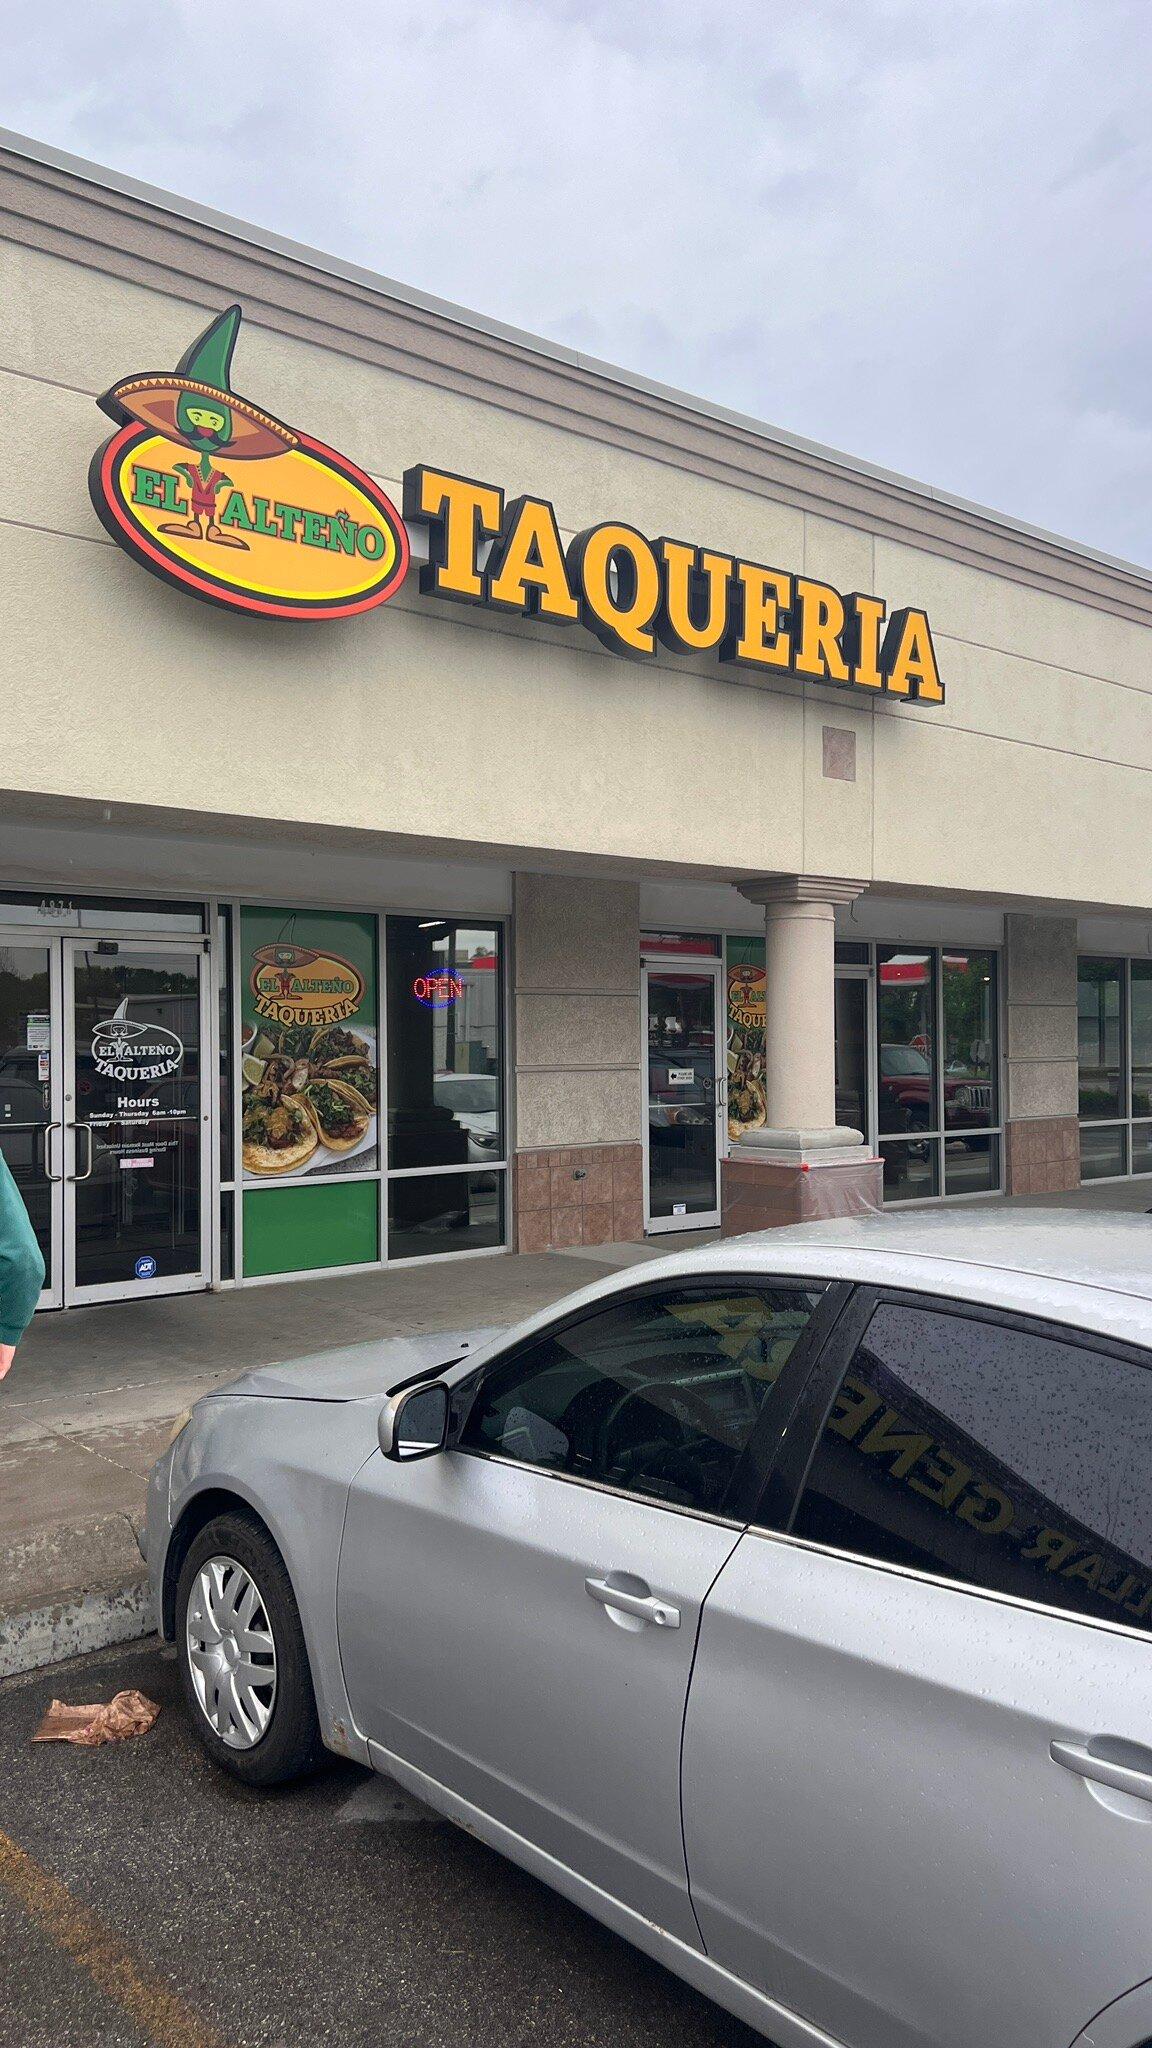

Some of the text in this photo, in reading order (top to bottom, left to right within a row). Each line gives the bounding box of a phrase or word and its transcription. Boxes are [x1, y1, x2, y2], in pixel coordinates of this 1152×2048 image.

[131, 466, 386, 562] EL ALTEÑO
[410, 464, 945, 705] TAQUERIA
[260, 977, 354, 993] EL ALTEÑO
[413, 977, 463, 998] OPEN
[254, 994, 360, 1028] TAQUERIA
[99, 1044, 174, 1056] EL ALTEÑO
[95, 1059, 178, 1081] TAQUERIA
[117, 1097, 160, 1108] Hours
[139, 1262, 153, 1271] ADT
